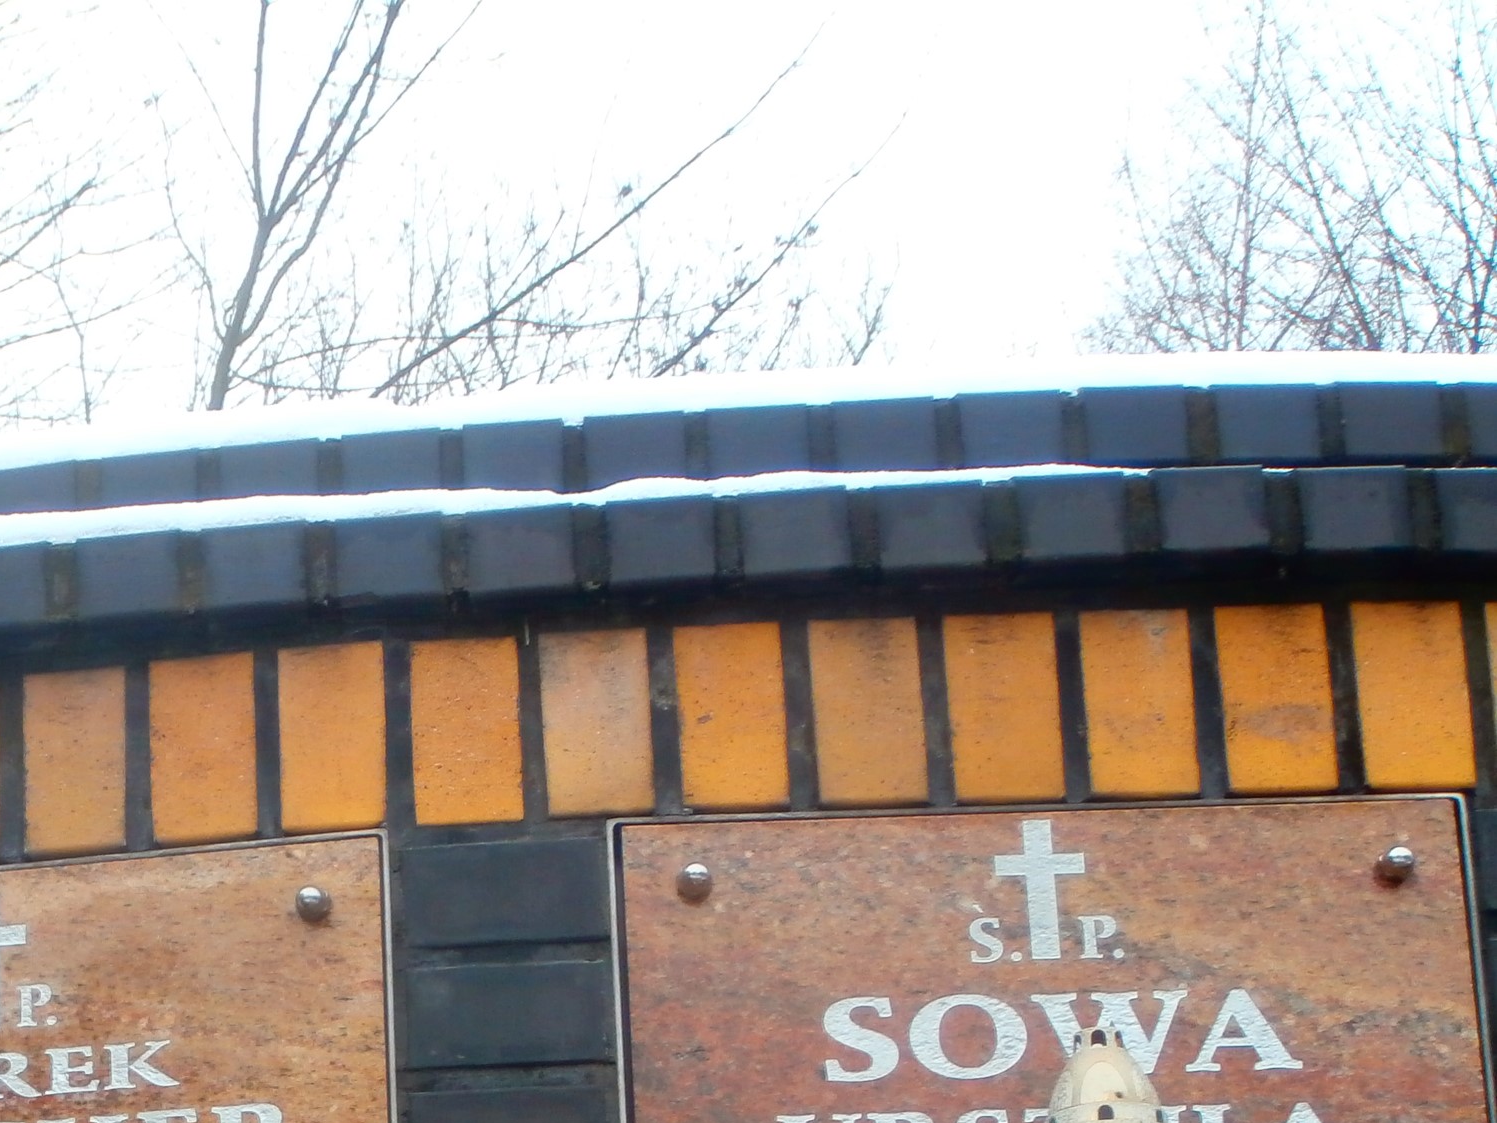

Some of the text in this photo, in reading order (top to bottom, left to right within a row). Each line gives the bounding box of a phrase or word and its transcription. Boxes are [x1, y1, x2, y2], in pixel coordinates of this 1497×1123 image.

[1077, 914, 1126, 960] P.
[15, 983, 59, 1028] P.
[822, 987, 1304, 1084] SOWA
